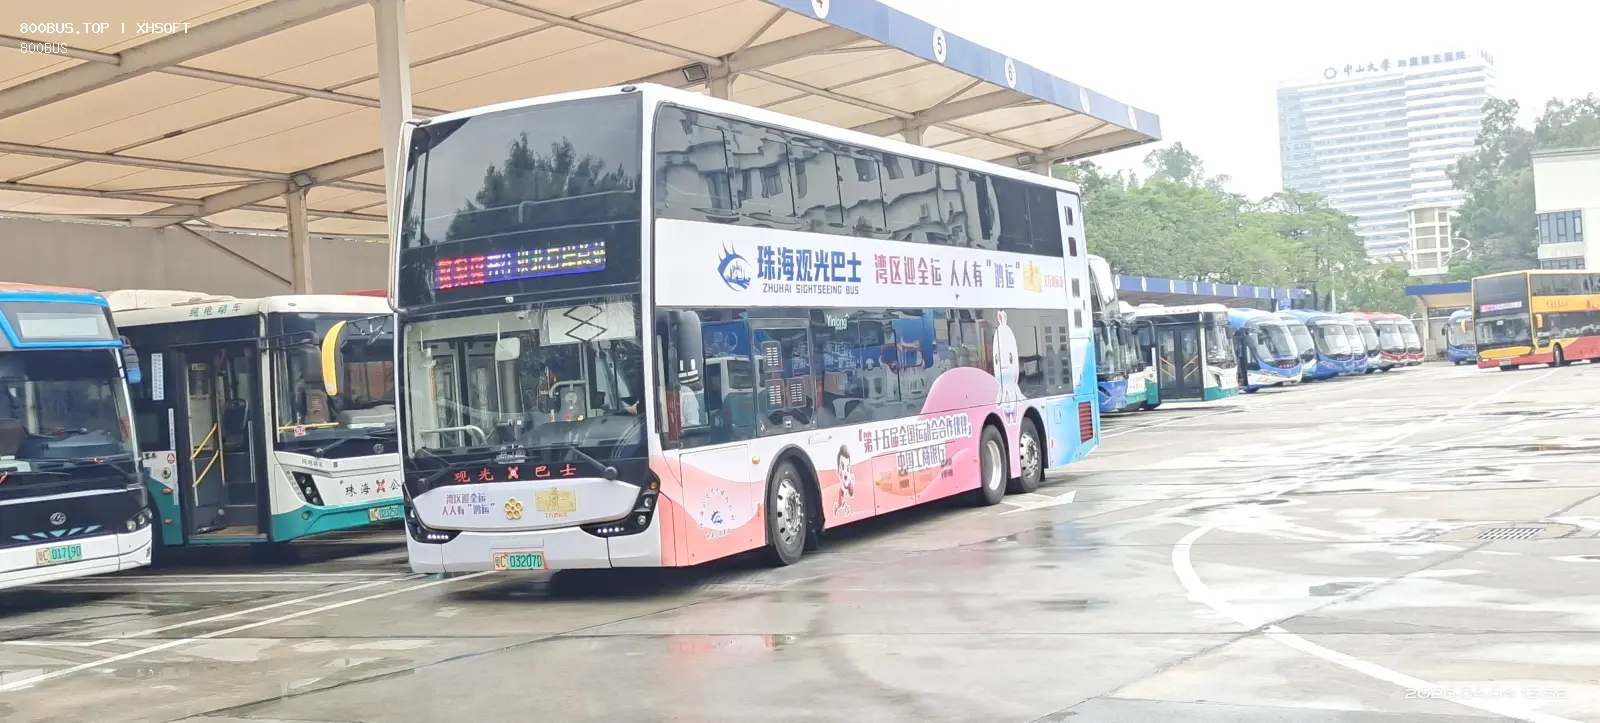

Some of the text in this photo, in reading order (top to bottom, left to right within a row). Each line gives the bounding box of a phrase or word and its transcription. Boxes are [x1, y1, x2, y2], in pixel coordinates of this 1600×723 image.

[937, 36, 943, 55] 5
[1008, 64, 1013, 81] 6
[757, 245, 862, 283] 珠海观光巴士
[874, 253, 942, 286] 湾区迎全运
[762, 282, 859, 295] ZHUHAI SIGHTSEEING BUS
[189, 303, 243, 317] 纯电动车
[897, 445, 945, 469] 中国工商银行
[454, 464, 577, 483] 观光 巴士
[345, 478, 401, 497] 珠海 公
[509, 554, 543, 568] 03207D
